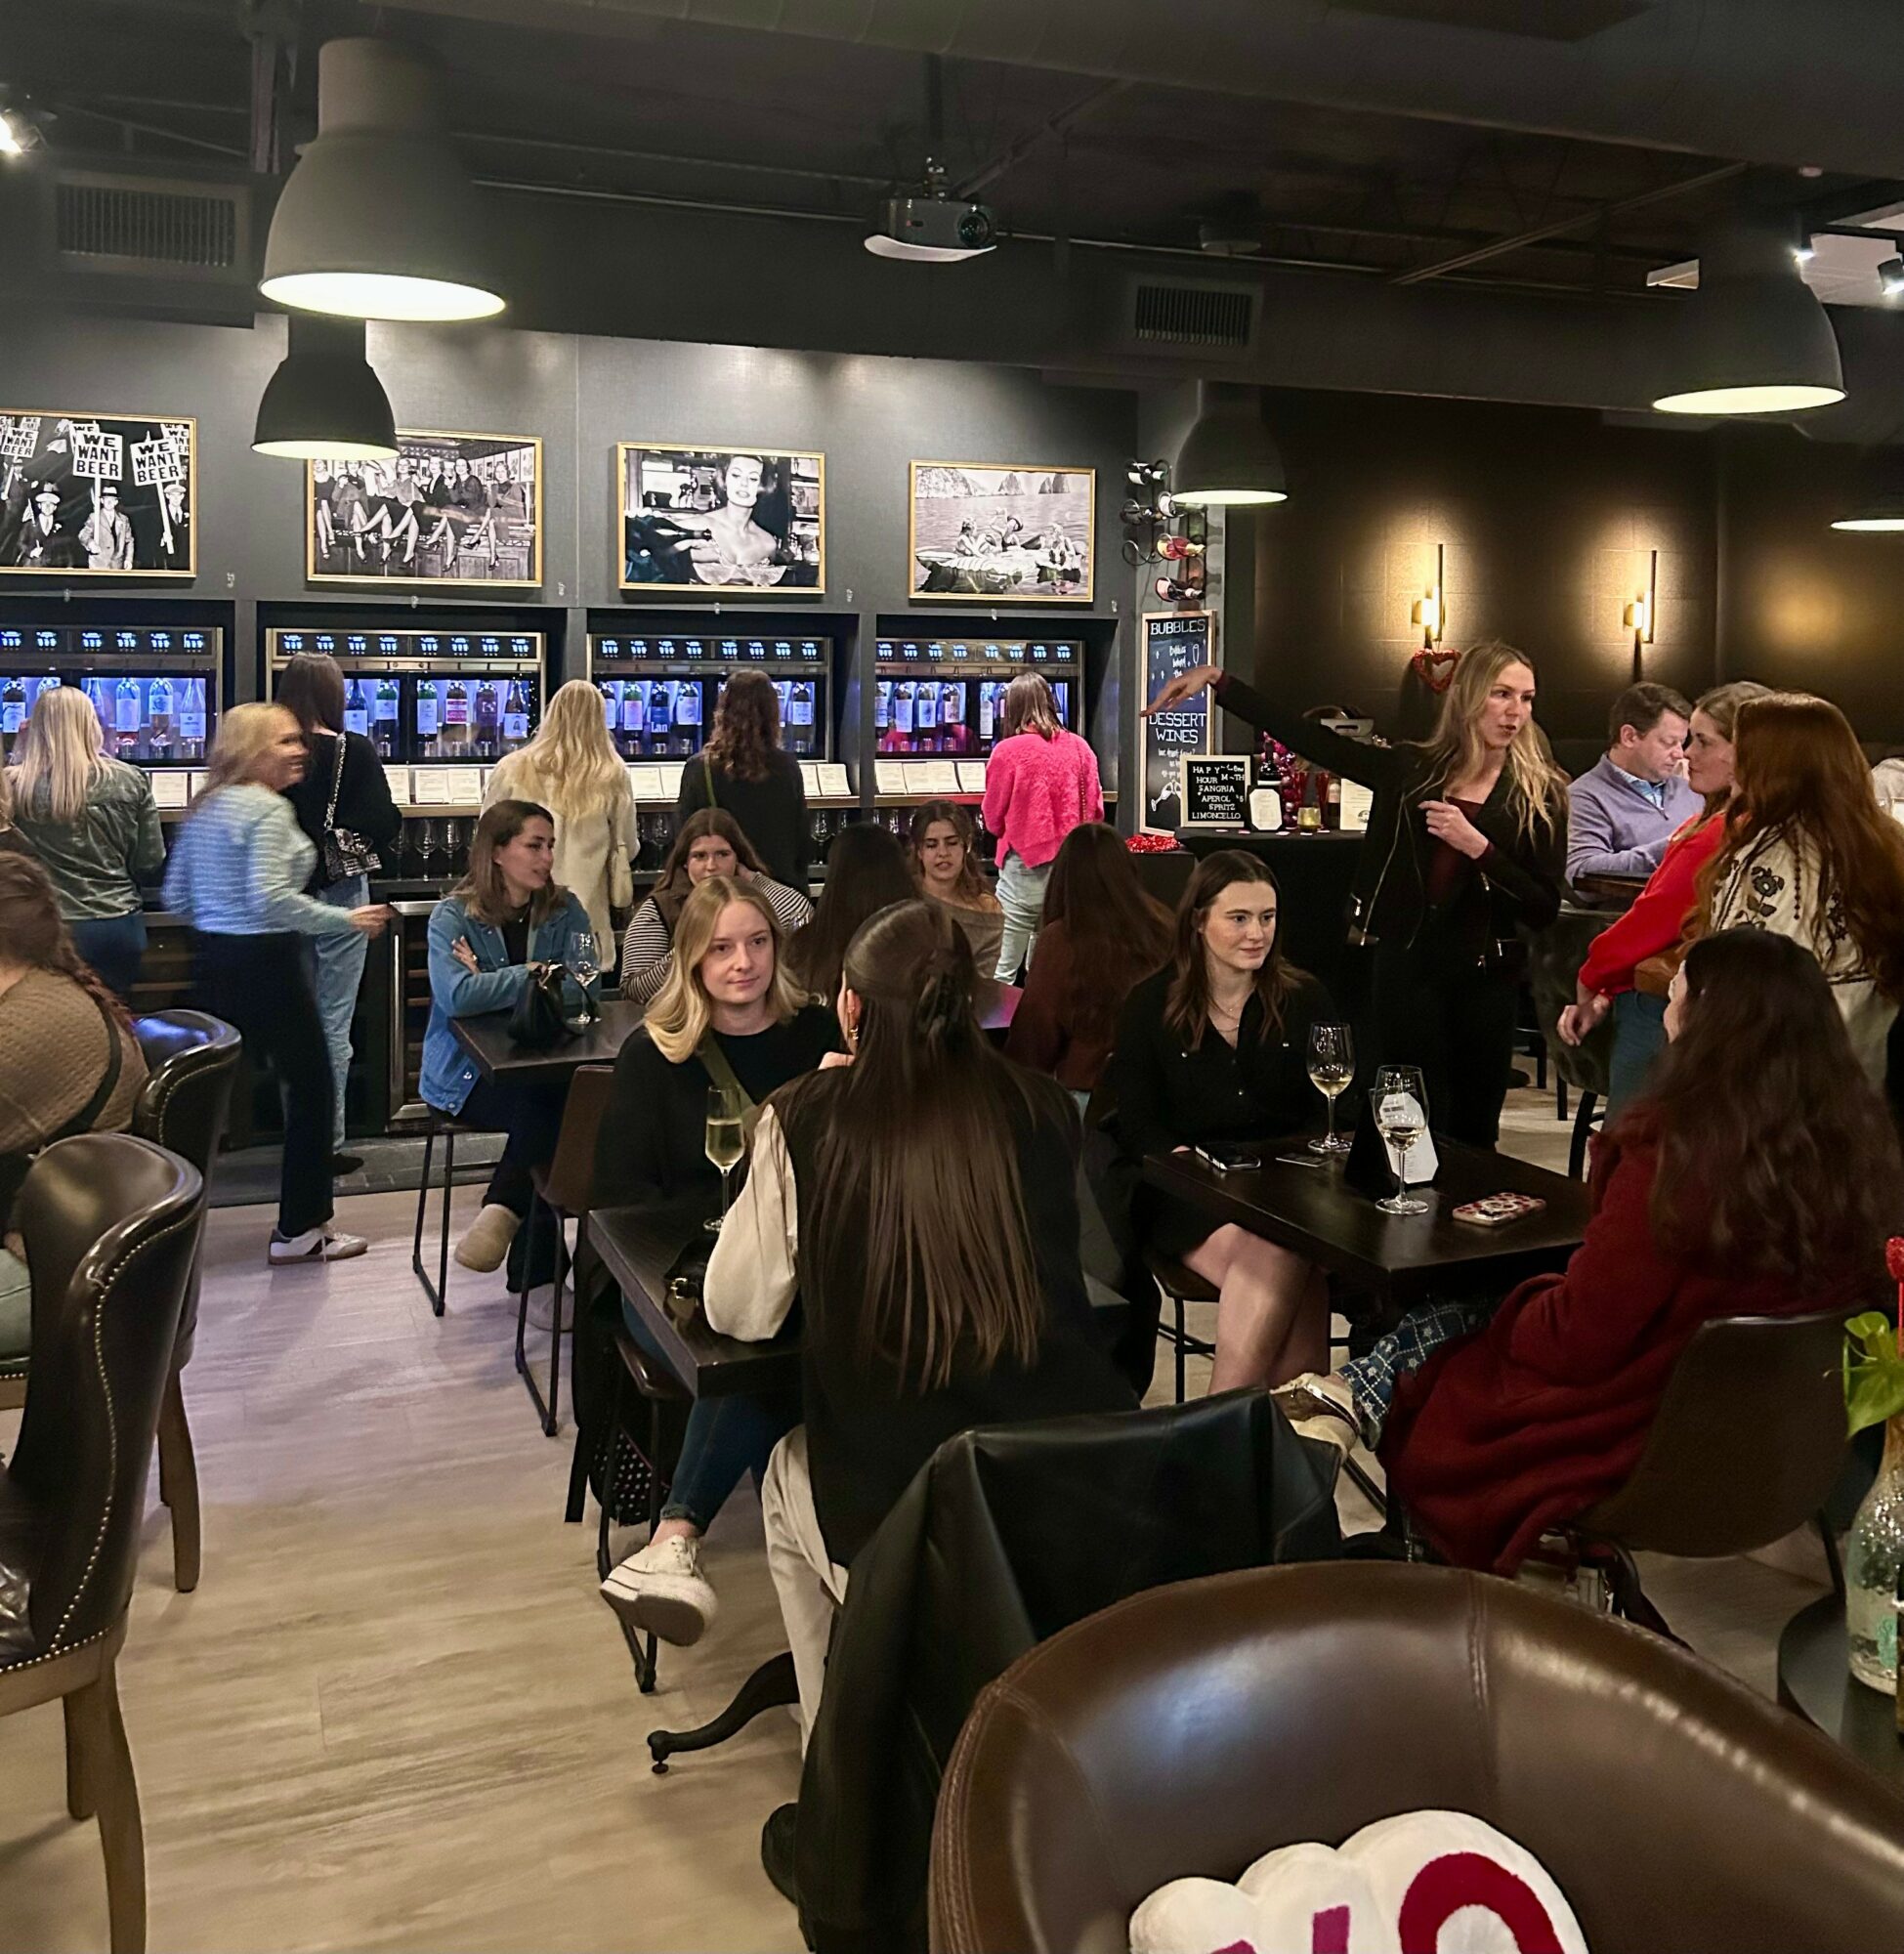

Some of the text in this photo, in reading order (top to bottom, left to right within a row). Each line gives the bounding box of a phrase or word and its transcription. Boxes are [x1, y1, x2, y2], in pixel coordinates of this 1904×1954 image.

[12, 429, 34, 439] WE
[83, 434, 115, 447] WE
[7, 436, 34, 447] WANT
[3, 445, 32, 455] BEER
[78, 445, 119, 462] WANT
[138, 442, 170, 455] WE
[135, 451, 175, 469] WANT
[76, 459, 119, 477] BEER
[137, 465, 179, 483] BEER
[1150, 618, 1206, 636] BUBBLES
[1149, 712, 1207, 728] DESSERT
[1155, 727, 1199, 744] WINES
[1196, 776, 1218, 785] HOUR
[1198, 785, 1235, 793] SANGRIA
[1201, 794, 1231, 803] APEROL
[1208, 803, 1236, 812] SPRITZ
[1191, 811, 1242, 820] LIMONCELLO
